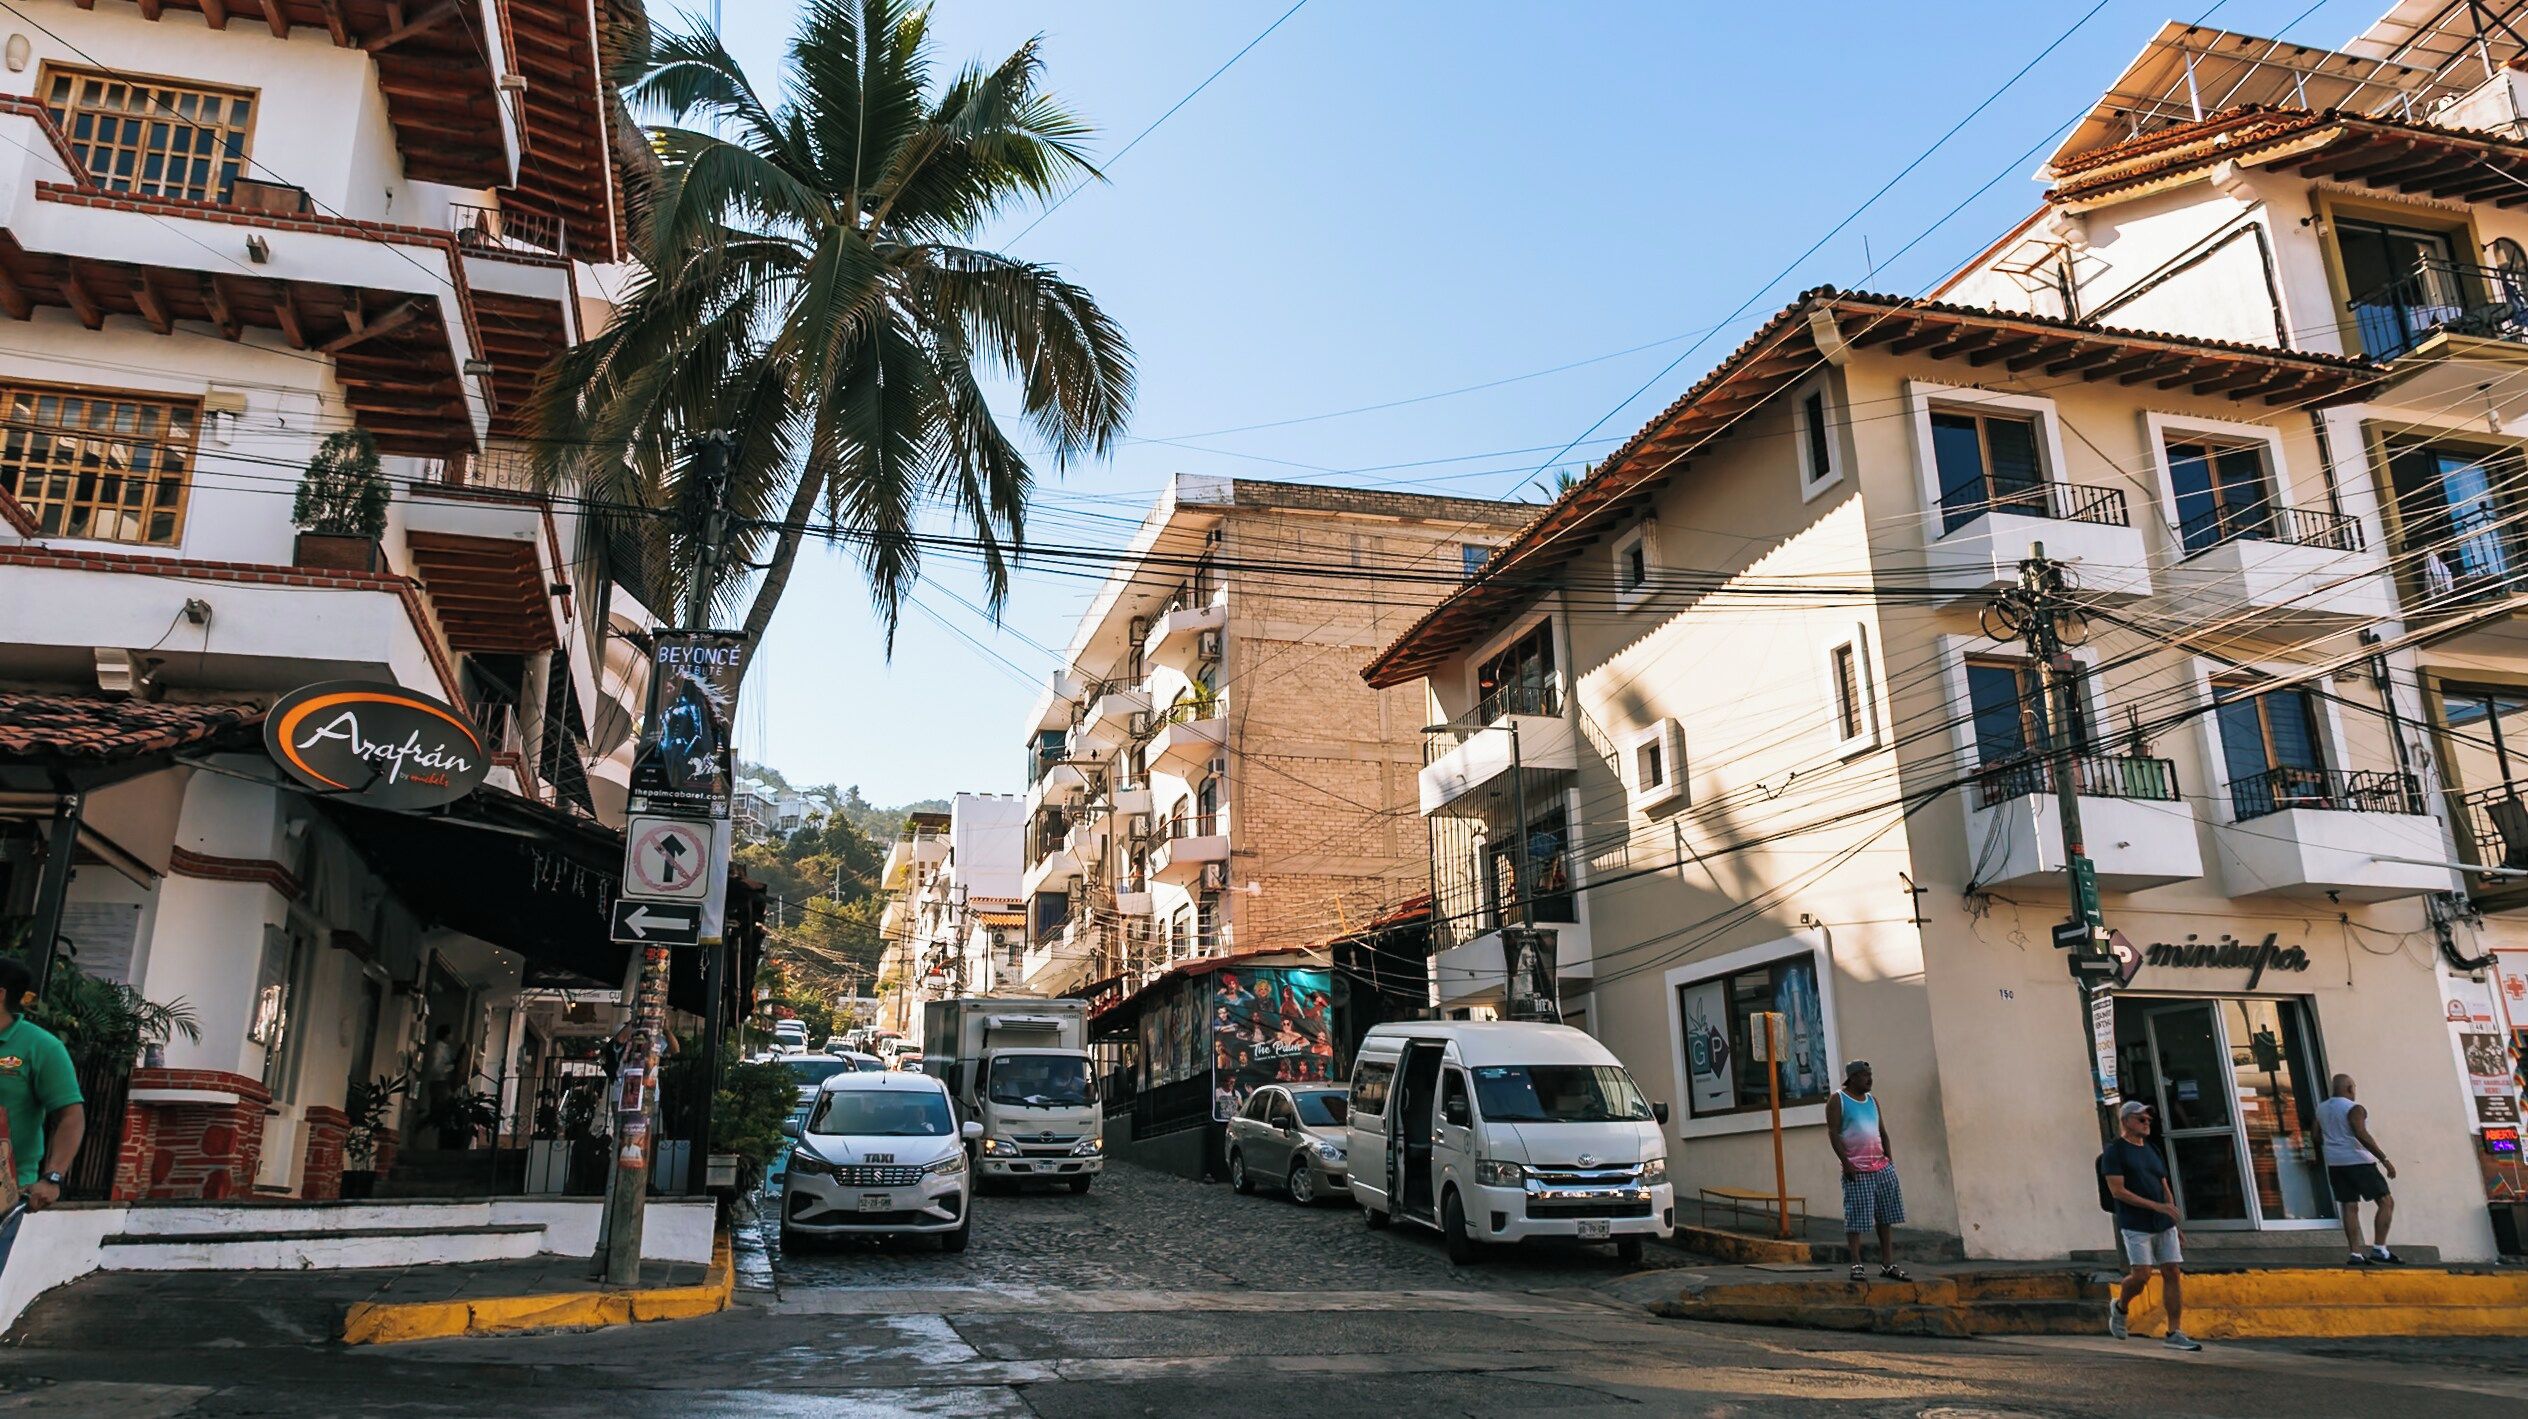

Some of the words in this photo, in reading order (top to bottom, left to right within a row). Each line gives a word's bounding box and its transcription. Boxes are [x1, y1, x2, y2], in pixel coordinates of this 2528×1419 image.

[658, 644, 741, 666] BEYONCÉ
[671, 664, 724, 676] TRIBUTE
[634, 788, 726, 800] thepalmcabaret.com
[1251, 1041, 1271, 1057] The
[1272, 1040, 1302, 1055] Palm
[2485, 1129, 2518, 1140] ABIERTO
[863, 1153, 895, 1164] TAXI
